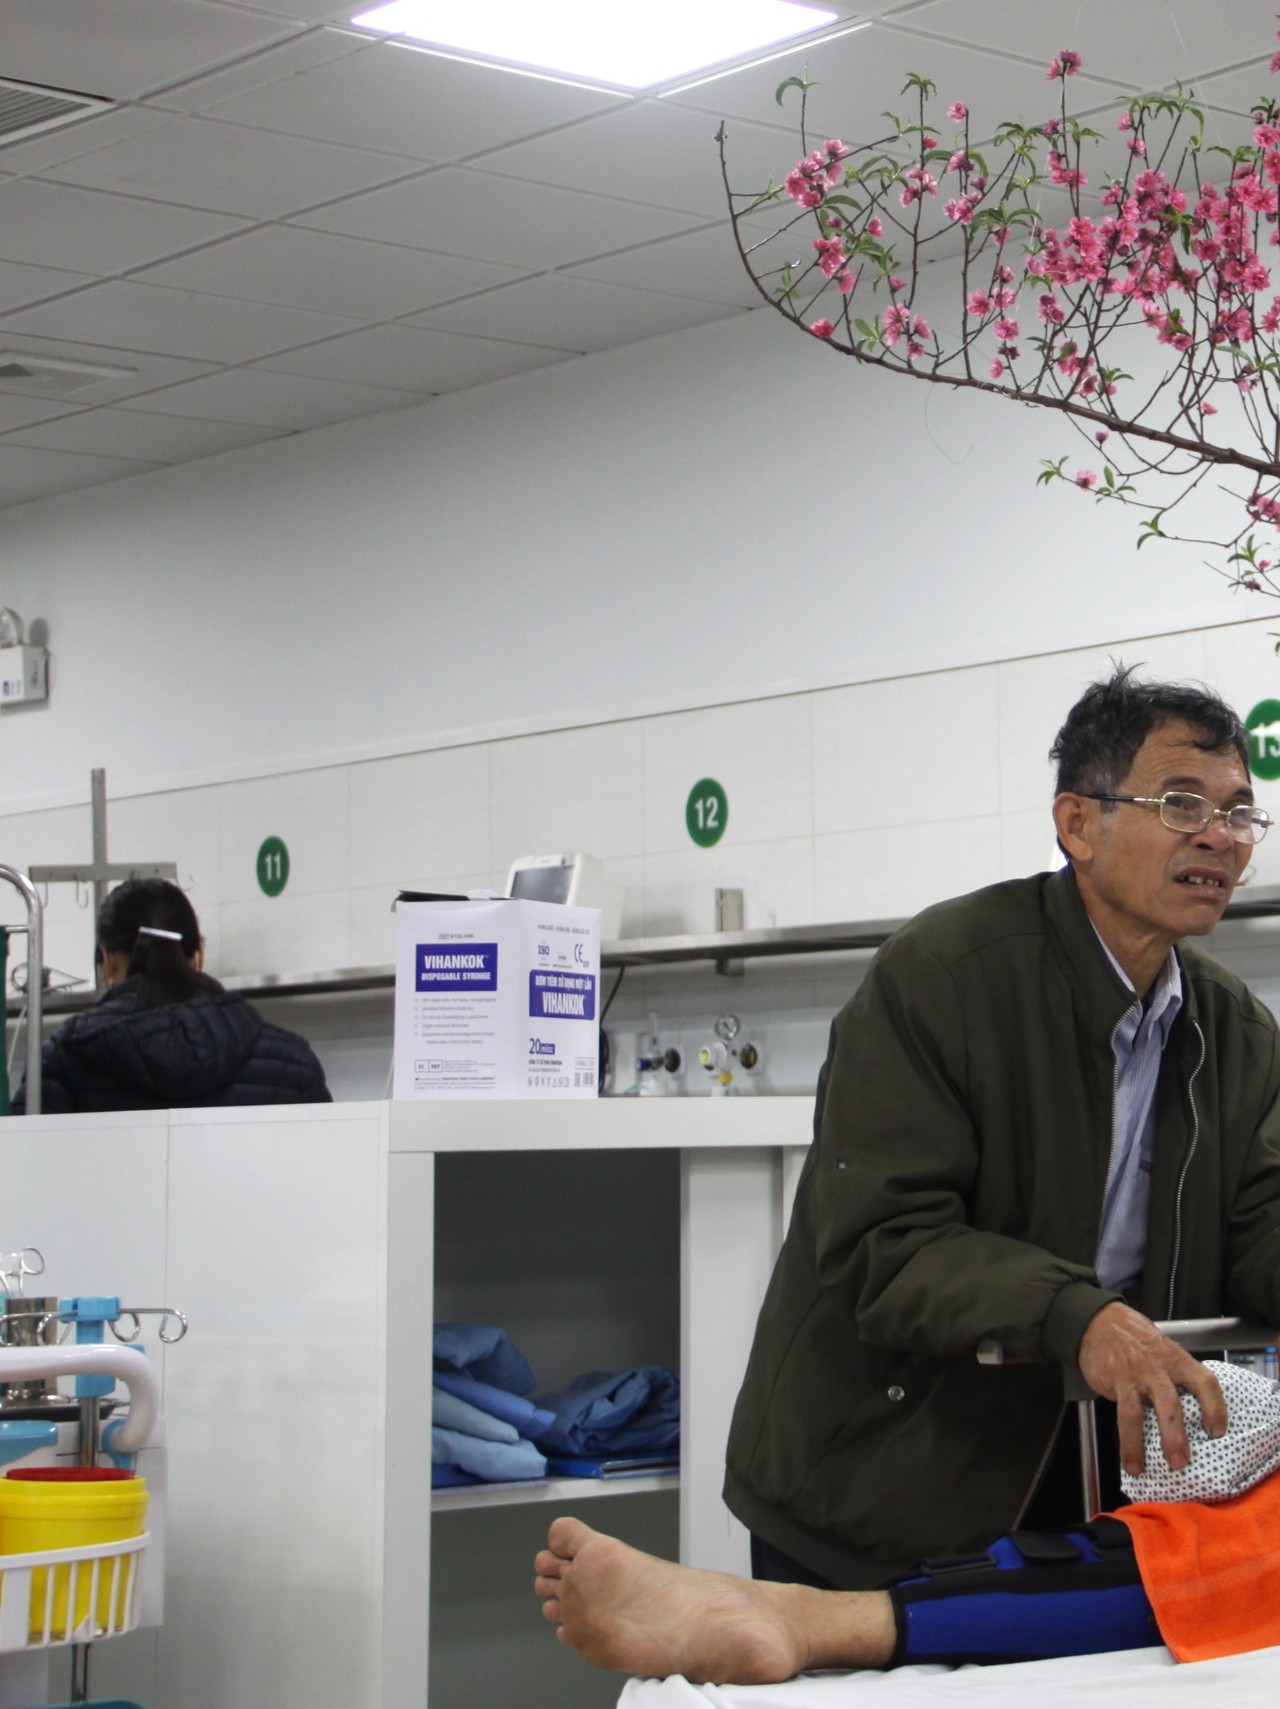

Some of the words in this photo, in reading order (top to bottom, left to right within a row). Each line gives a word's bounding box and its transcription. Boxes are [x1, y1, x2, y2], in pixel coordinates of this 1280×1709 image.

[694, 796, 719, 829] 12
[265, 852, 281, 881] 11
[424, 954, 485, 969] VIHANKOK
[421, 972, 461, 981] DISPOSABLE
[462, 972, 491, 980] SYRINGE
[542, 991, 585, 1015] VIHANKOK
